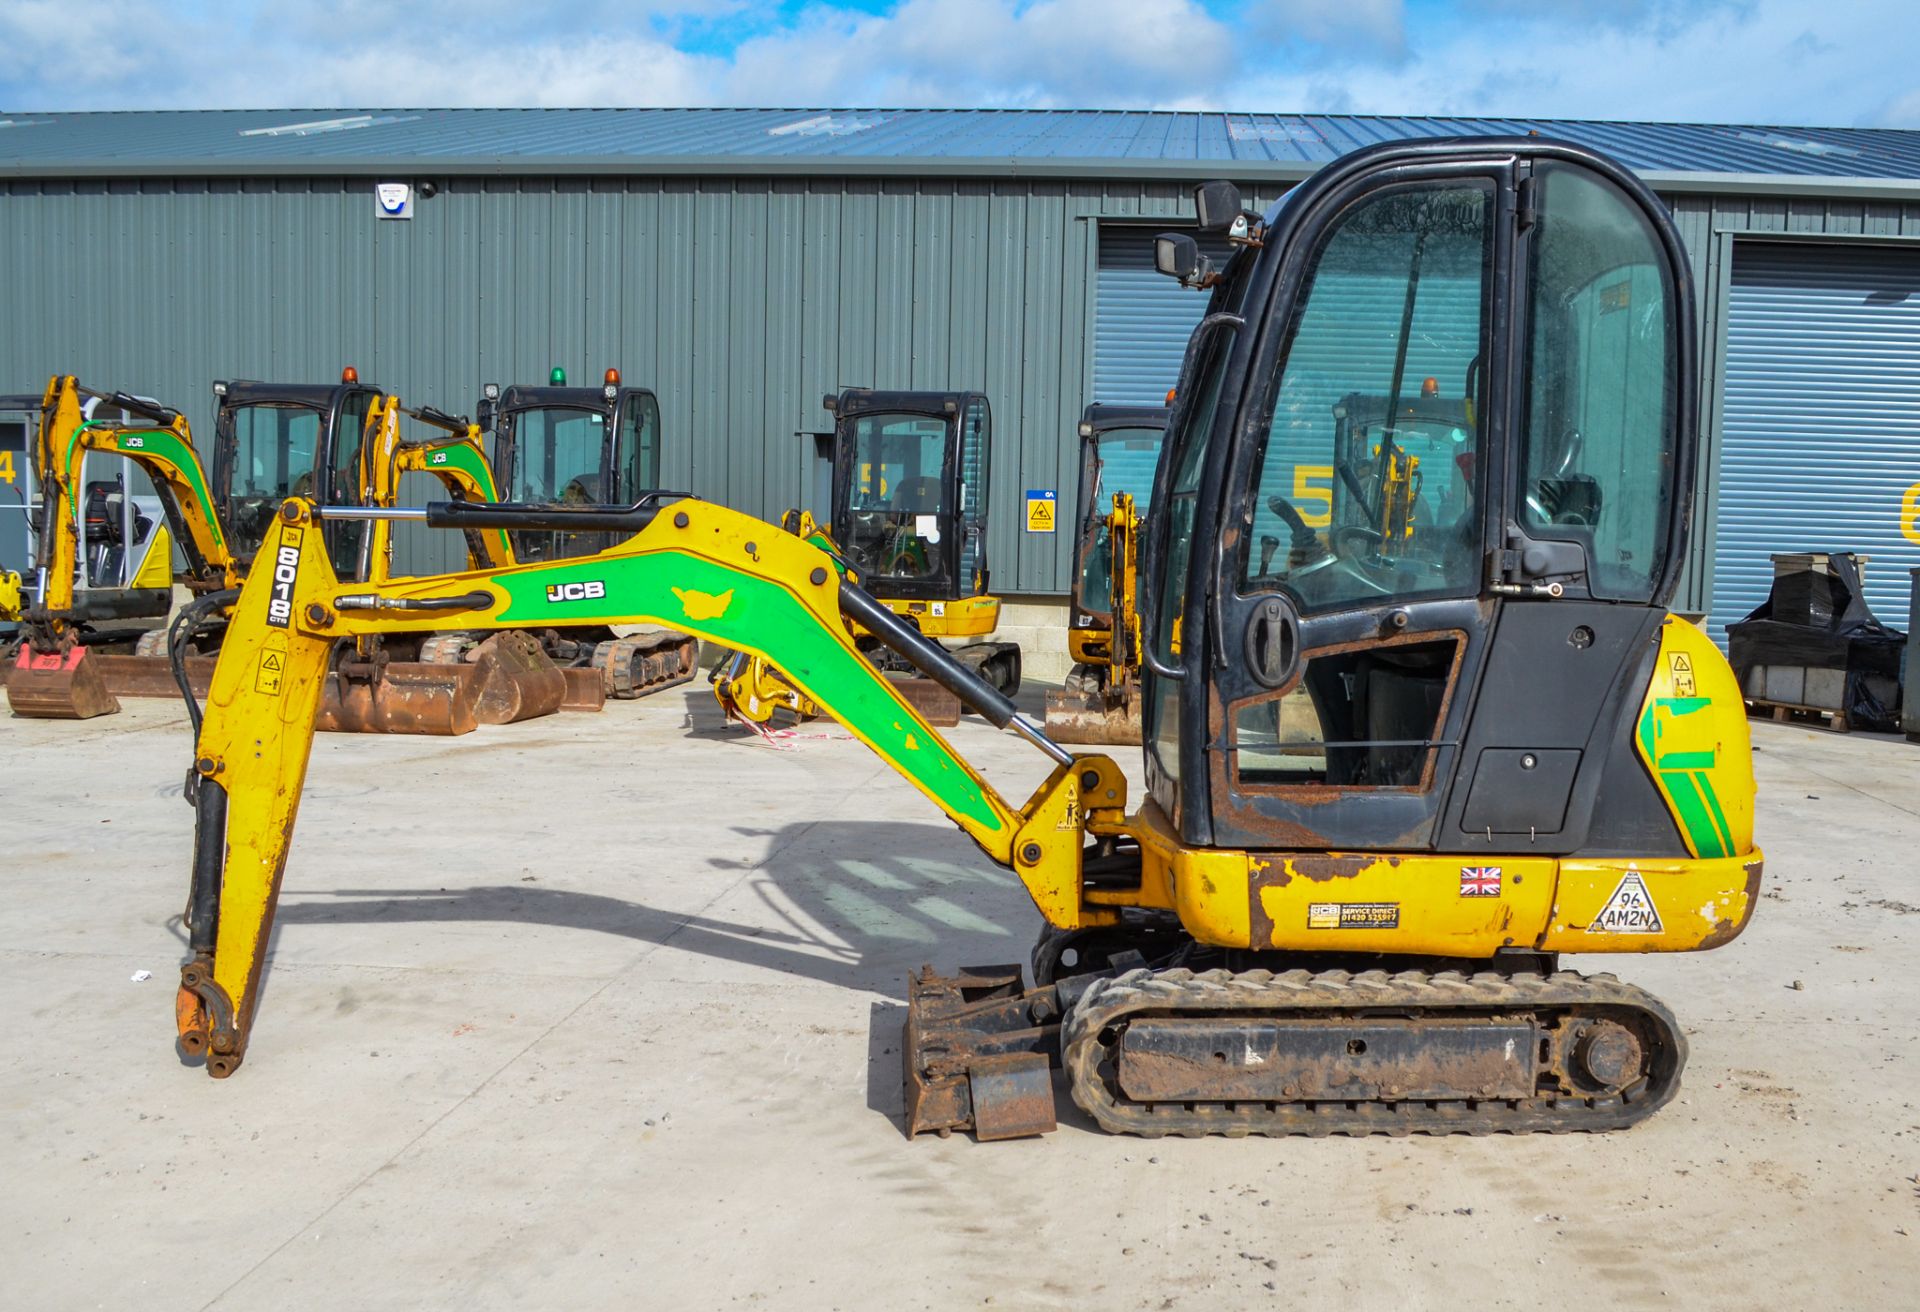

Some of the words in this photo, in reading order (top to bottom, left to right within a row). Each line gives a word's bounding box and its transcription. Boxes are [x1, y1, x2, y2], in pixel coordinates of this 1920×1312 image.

[126, 437, 144, 447] JCB
[0, 450, 17, 484] 4
[432, 452, 447, 463] JCB
[1293, 465, 1333, 528] 5
[269, 546, 299, 618] 8018
[547, 581, 605, 602] JCB
[1621, 892, 1641, 909] 96
[1605, 910, 1651, 926] AM2N
